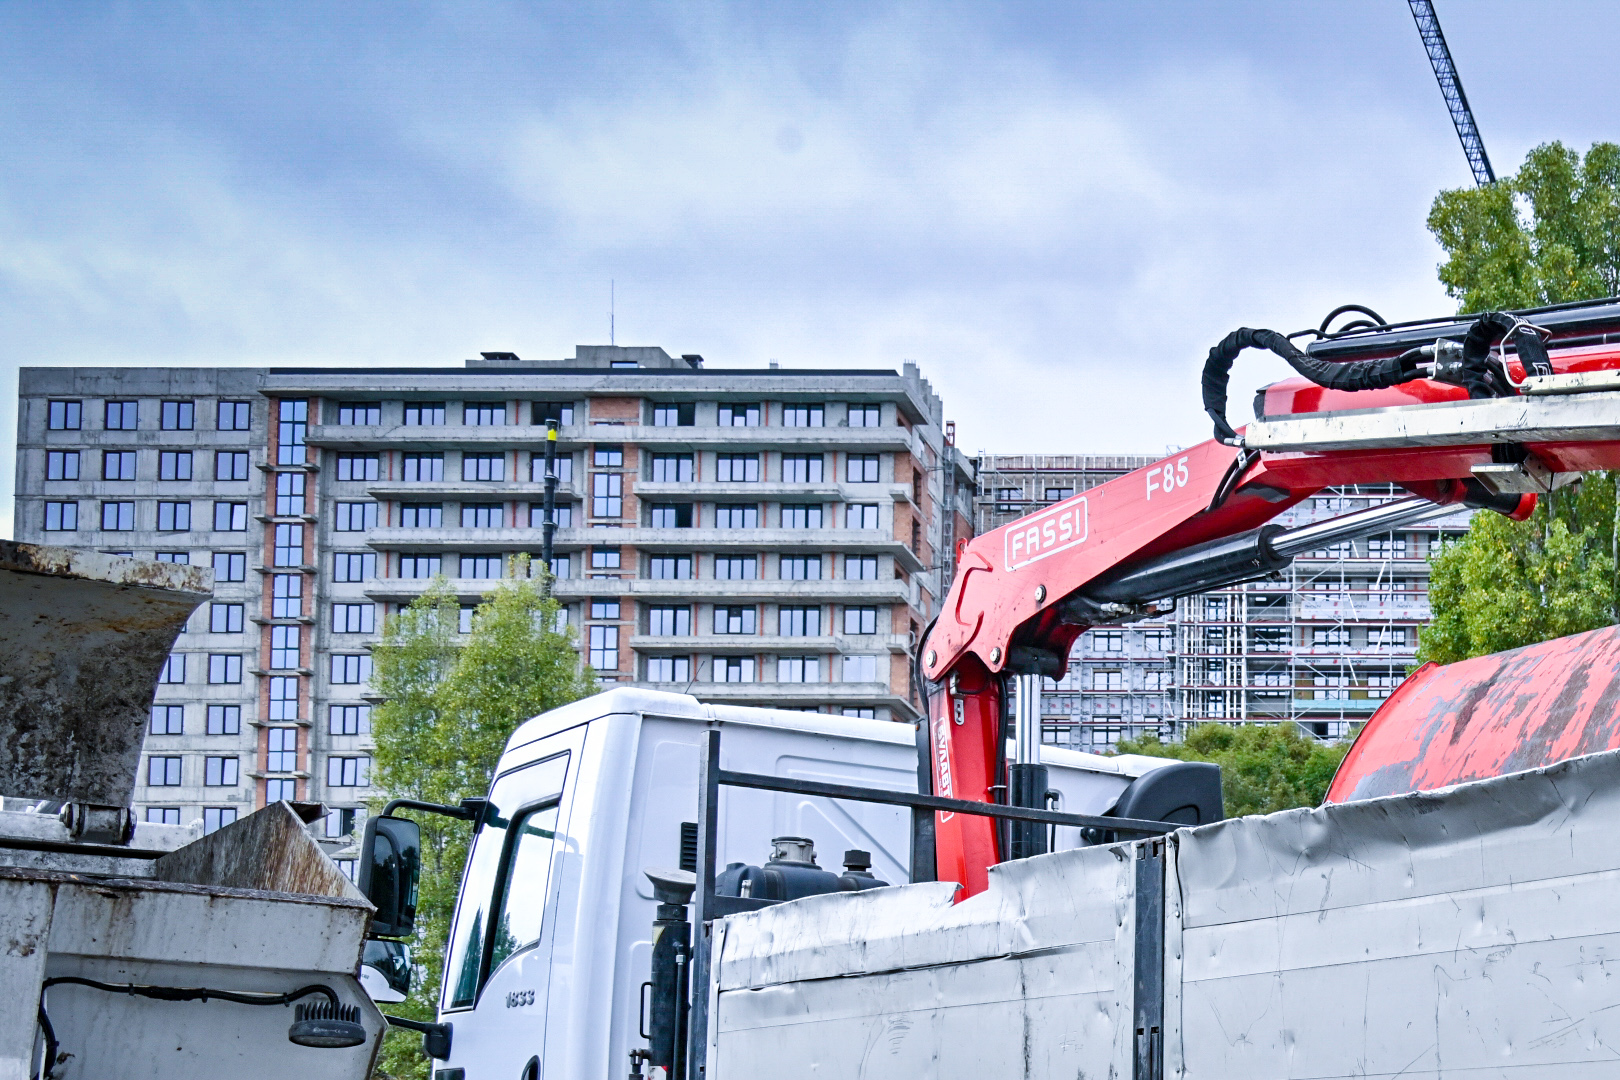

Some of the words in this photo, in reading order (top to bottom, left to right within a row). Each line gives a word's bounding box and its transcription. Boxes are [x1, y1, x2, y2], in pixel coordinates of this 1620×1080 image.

[1146, 456, 1189, 501] F85
[1012, 508, 1081, 560] FASSI
[936, 724, 951, 799] БУЛАВТ
